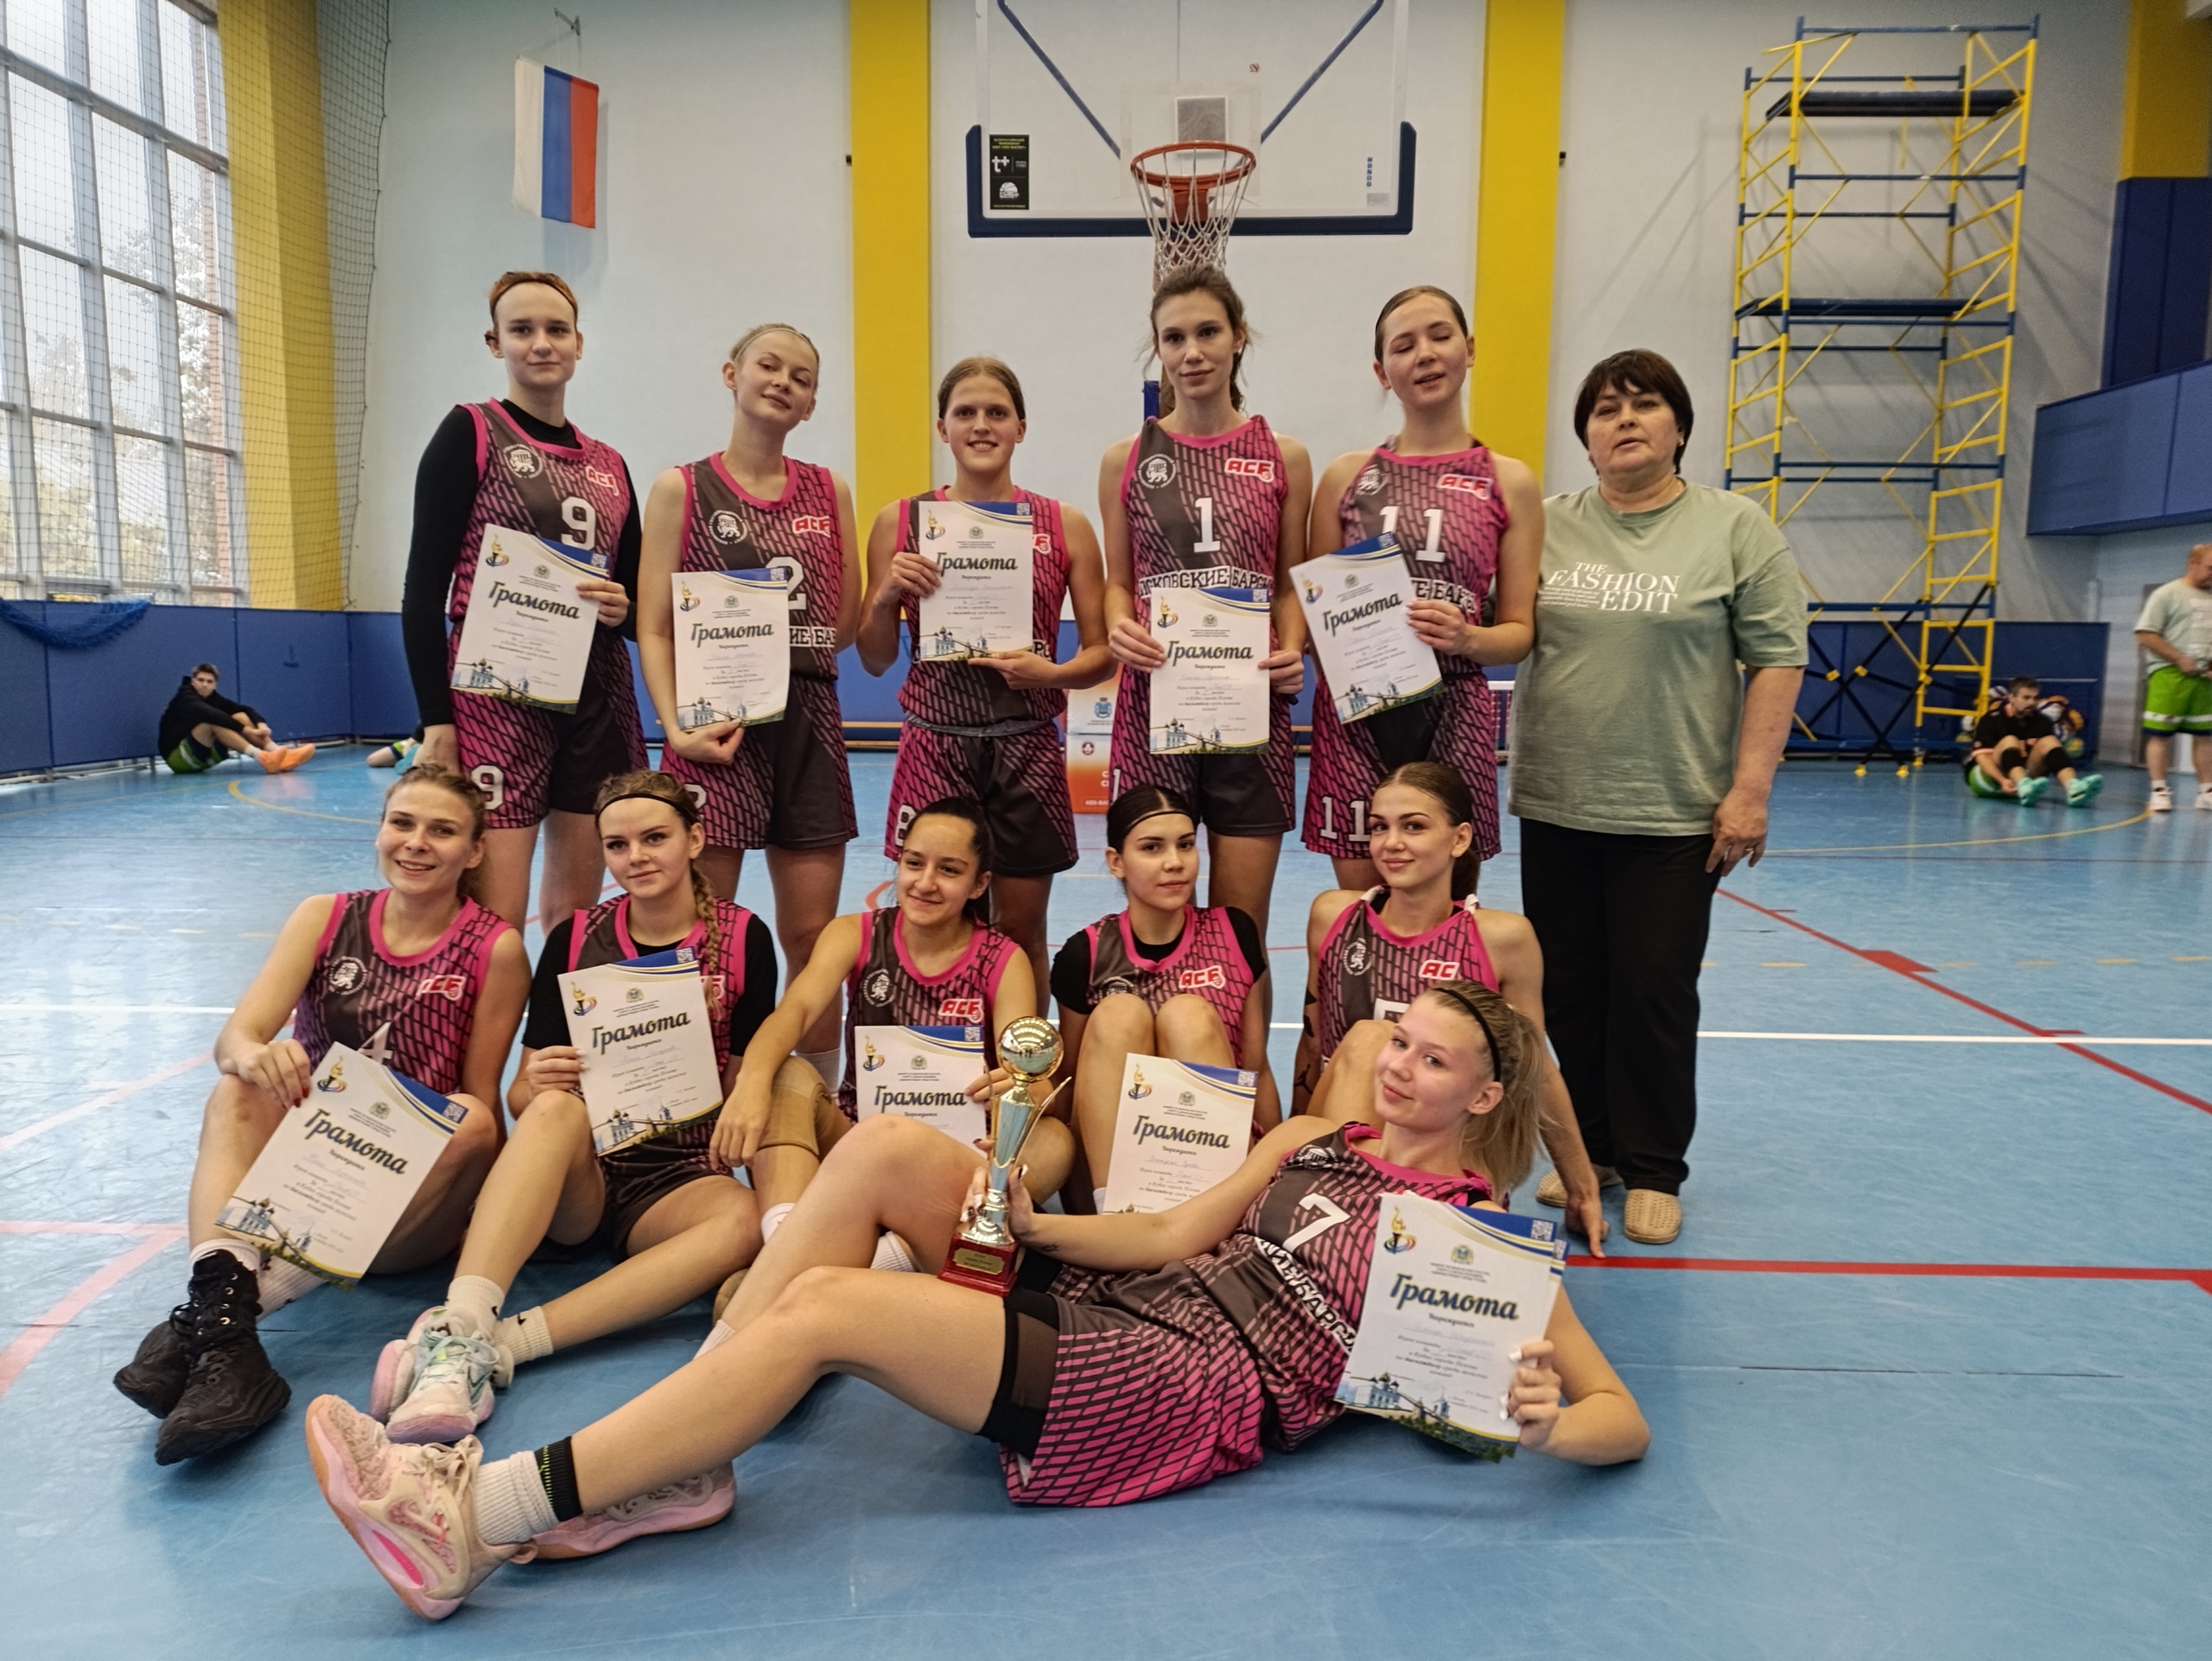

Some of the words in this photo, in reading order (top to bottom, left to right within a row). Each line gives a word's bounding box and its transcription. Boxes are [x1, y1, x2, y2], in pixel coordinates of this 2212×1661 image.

[561, 496, 595, 550] 9
[1194, 497, 1221, 553] 1
[1379, 506, 1446, 563] 11
[766, 556, 807, 610] 2
[937, 551, 1018, 577] Грамота
[1545, 570, 1681, 594] FASHION
[1575, 562, 1608, 574] THE
[489, 581, 581, 620] Грамота
[1322, 592, 1403, 637] Грамота
[1599, 590, 1679, 614] EDIT
[690, 623, 774, 648] Грамота
[1166, 640, 1255, 667] Грамота
[471, 765, 504, 810] 9
[1319, 795, 1371, 842] 11
[1418, 959, 1460, 981] АС
[356, 1021, 394, 1065] 4
[592, 1012, 691, 1055] Грамота
[874, 1085, 967, 1114] Грамота
[304, 1108, 409, 1174] Грамота
[1133, 1115, 1230, 1149] Грамота
[1282, 1192, 1351, 1254] 7
[1389, 1273, 1520, 1321] Грамота
